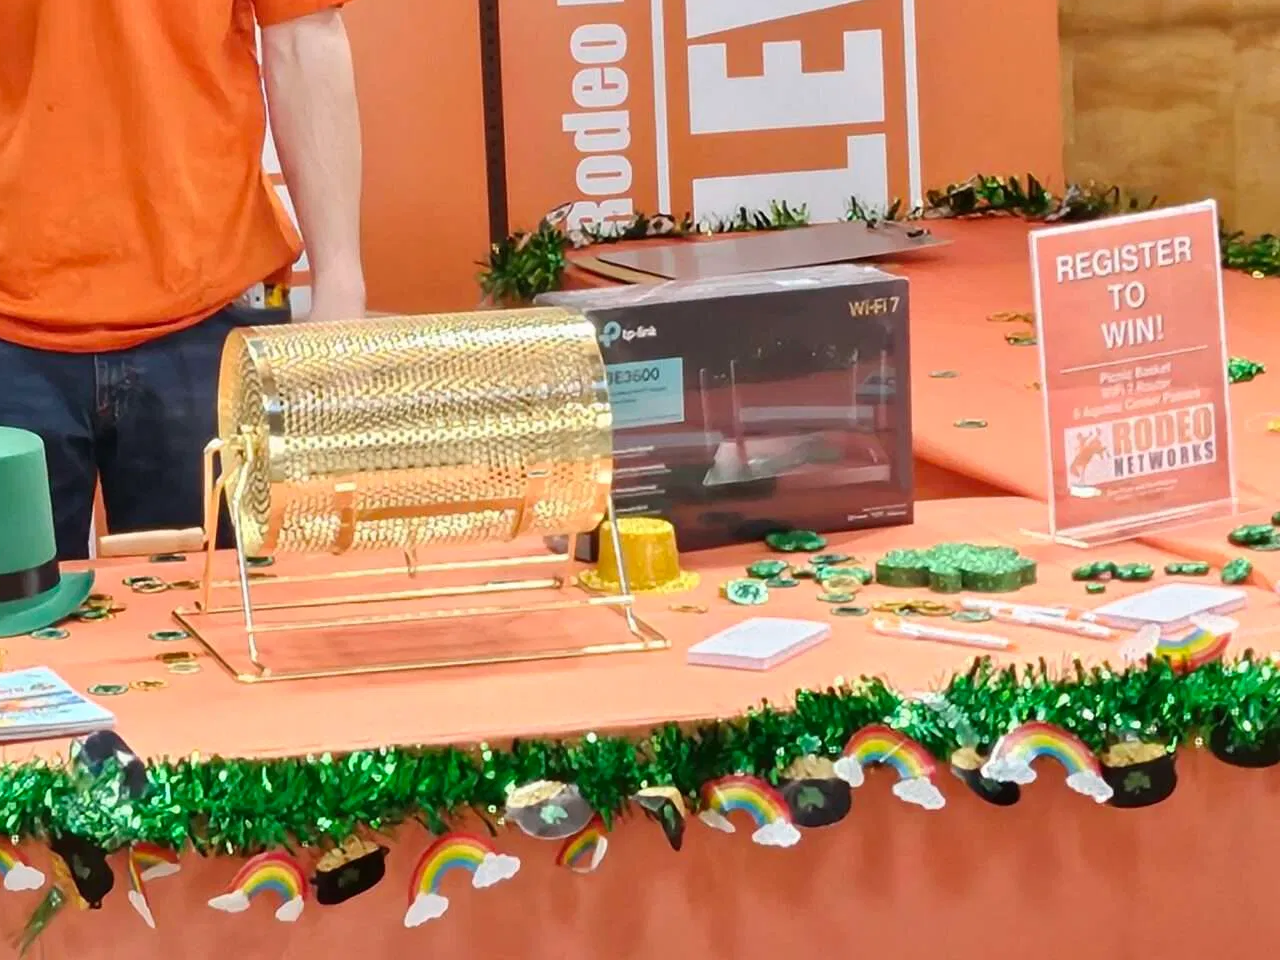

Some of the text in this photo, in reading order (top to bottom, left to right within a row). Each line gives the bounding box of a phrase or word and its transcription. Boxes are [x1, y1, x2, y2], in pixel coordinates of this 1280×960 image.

[1056, 236, 1193, 283] REGISTER
[889, 296, 900, 313] 7
[1107, 281, 1146, 311] TO
[1100, 314, 1165, 349] WIN!
[1112, 406, 1212, 456] RODEO
[1113, 440, 1214, 478] NETWORKS
